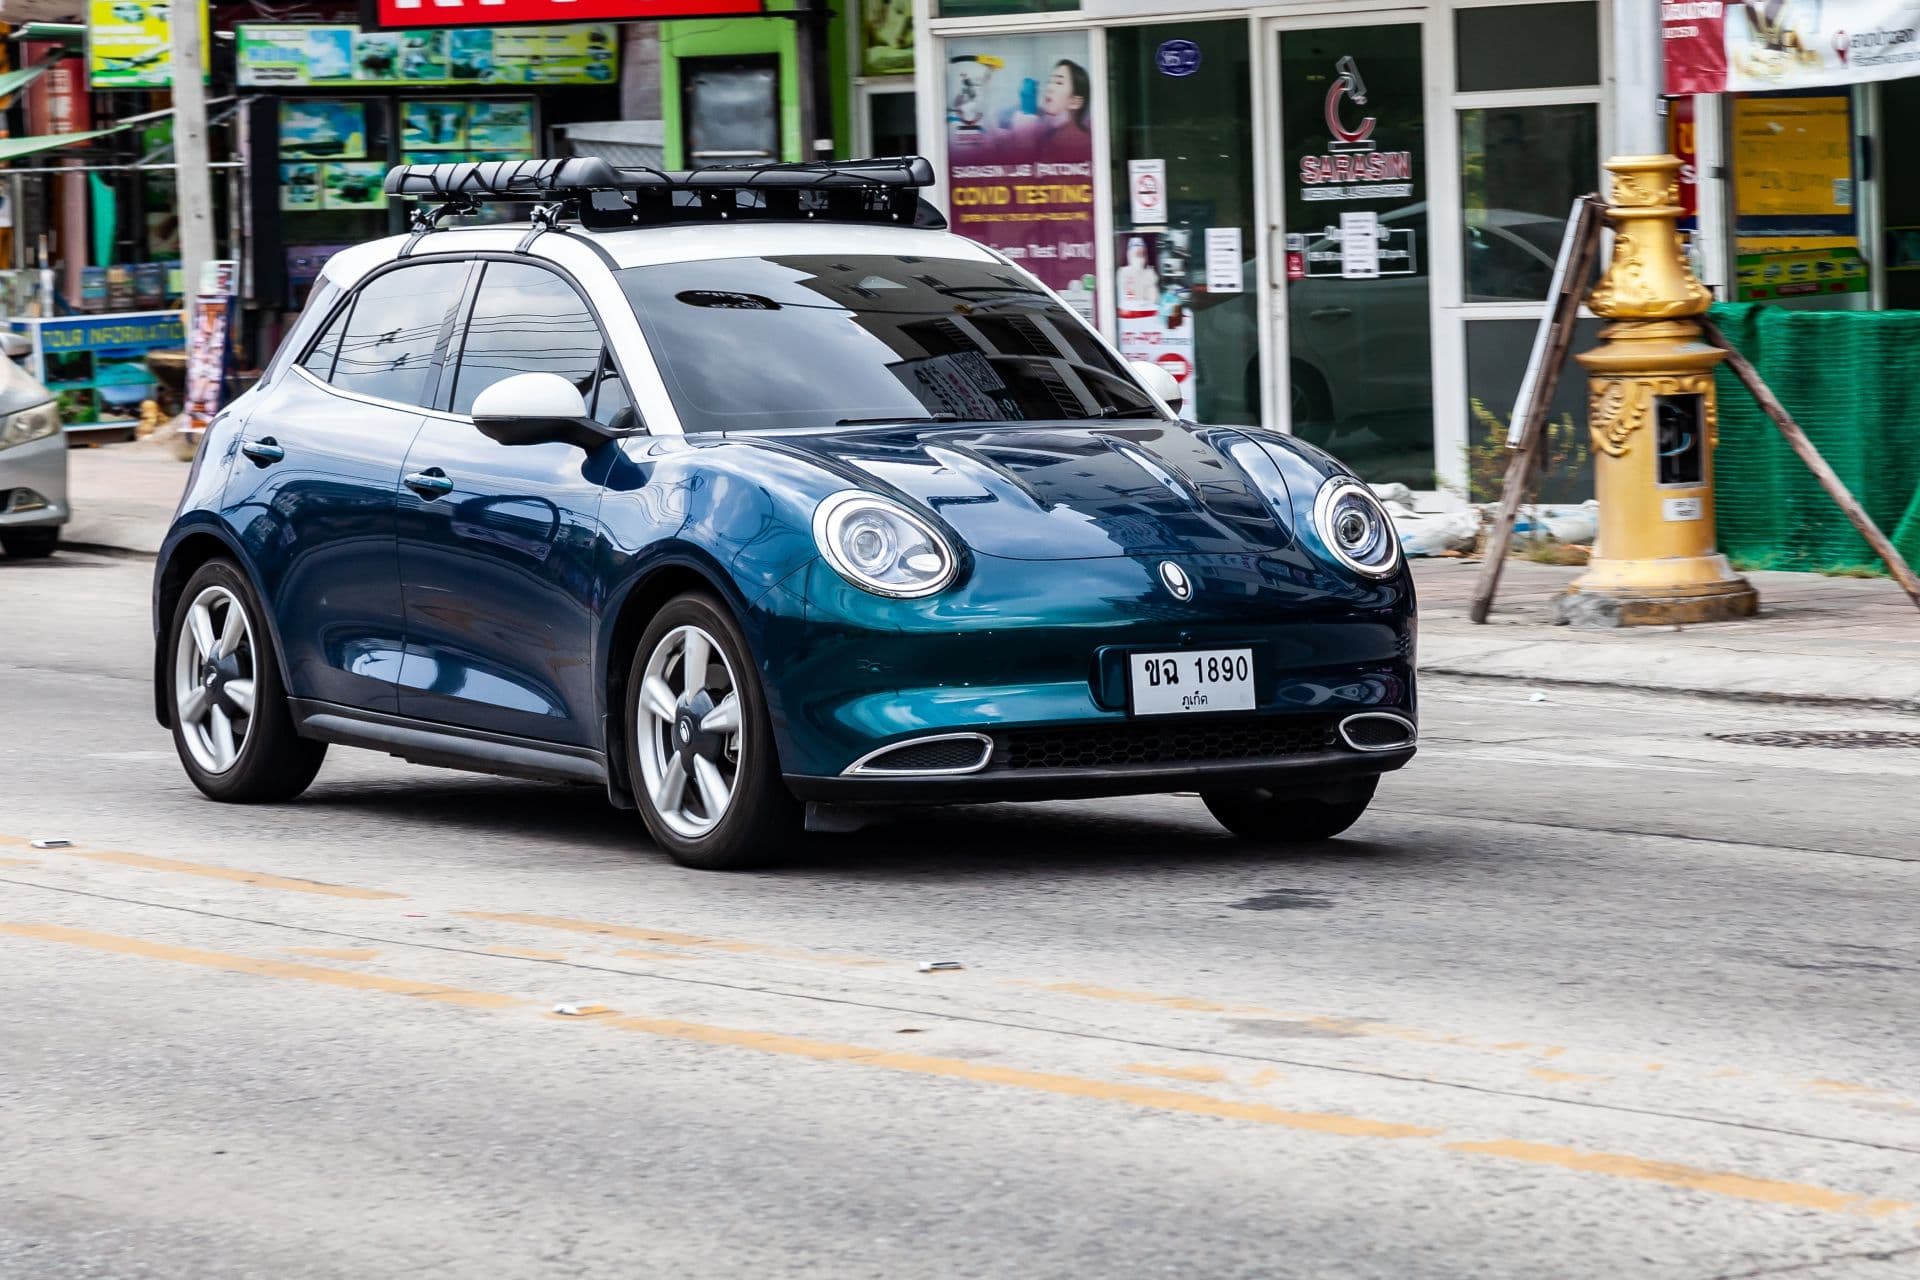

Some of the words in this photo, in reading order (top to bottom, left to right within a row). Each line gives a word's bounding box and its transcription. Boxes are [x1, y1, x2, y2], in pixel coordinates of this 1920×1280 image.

[1300, 151, 1412, 184] SARASIN
[951, 186, 1010, 206] COVID
[1013, 184, 1093, 204] TESTING
[43, 329, 84, 347] TOUR
[88, 322, 185, 346] INFORMATIO
[1194, 655, 1248, 684] 1890
[1181, 690, 1209, 710] ภูเก็ต
